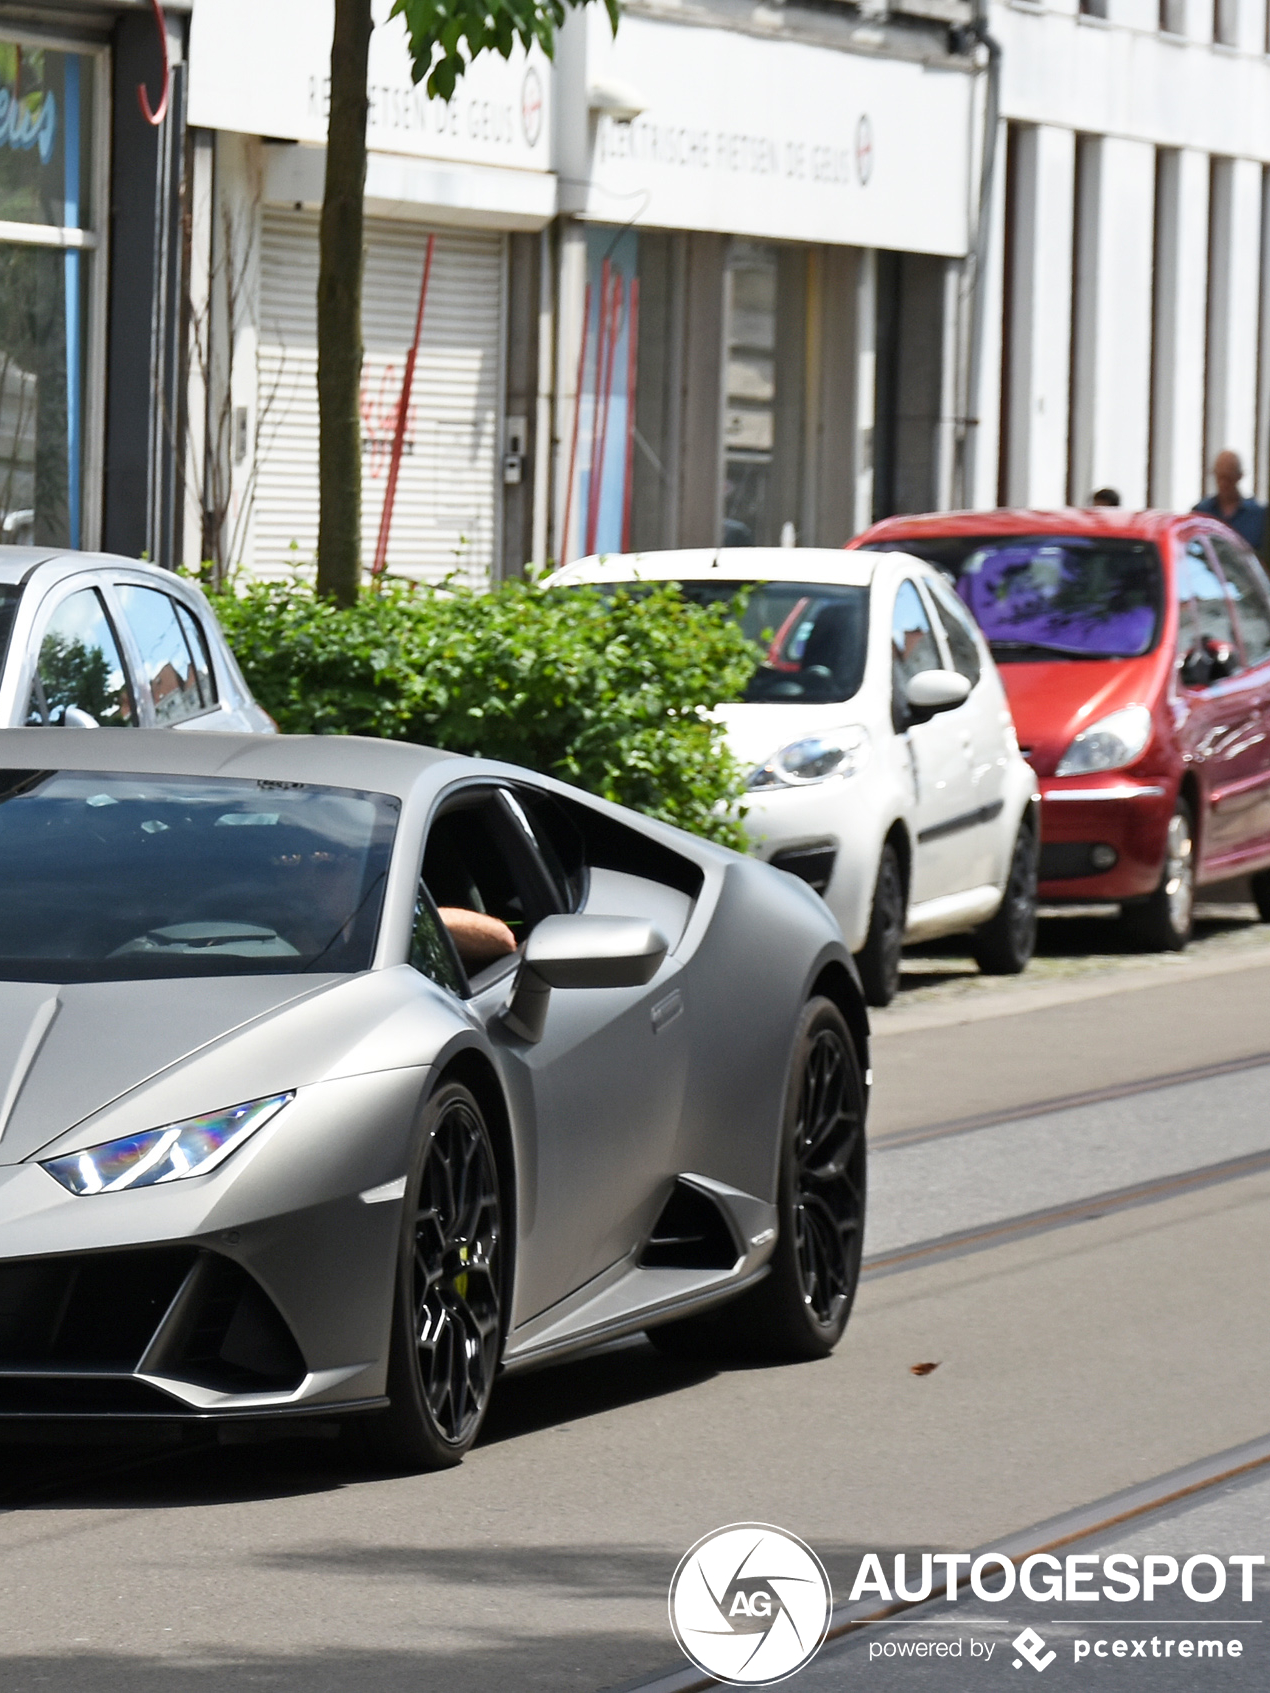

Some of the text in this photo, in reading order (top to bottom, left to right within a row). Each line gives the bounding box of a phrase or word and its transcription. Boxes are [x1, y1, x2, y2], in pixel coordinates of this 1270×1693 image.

[468, 100, 514, 143] GEUS
[715, 131, 780, 175] FIETSEN
[785, 140, 806, 180] DE
[811, 144, 851, 185] GEUS
